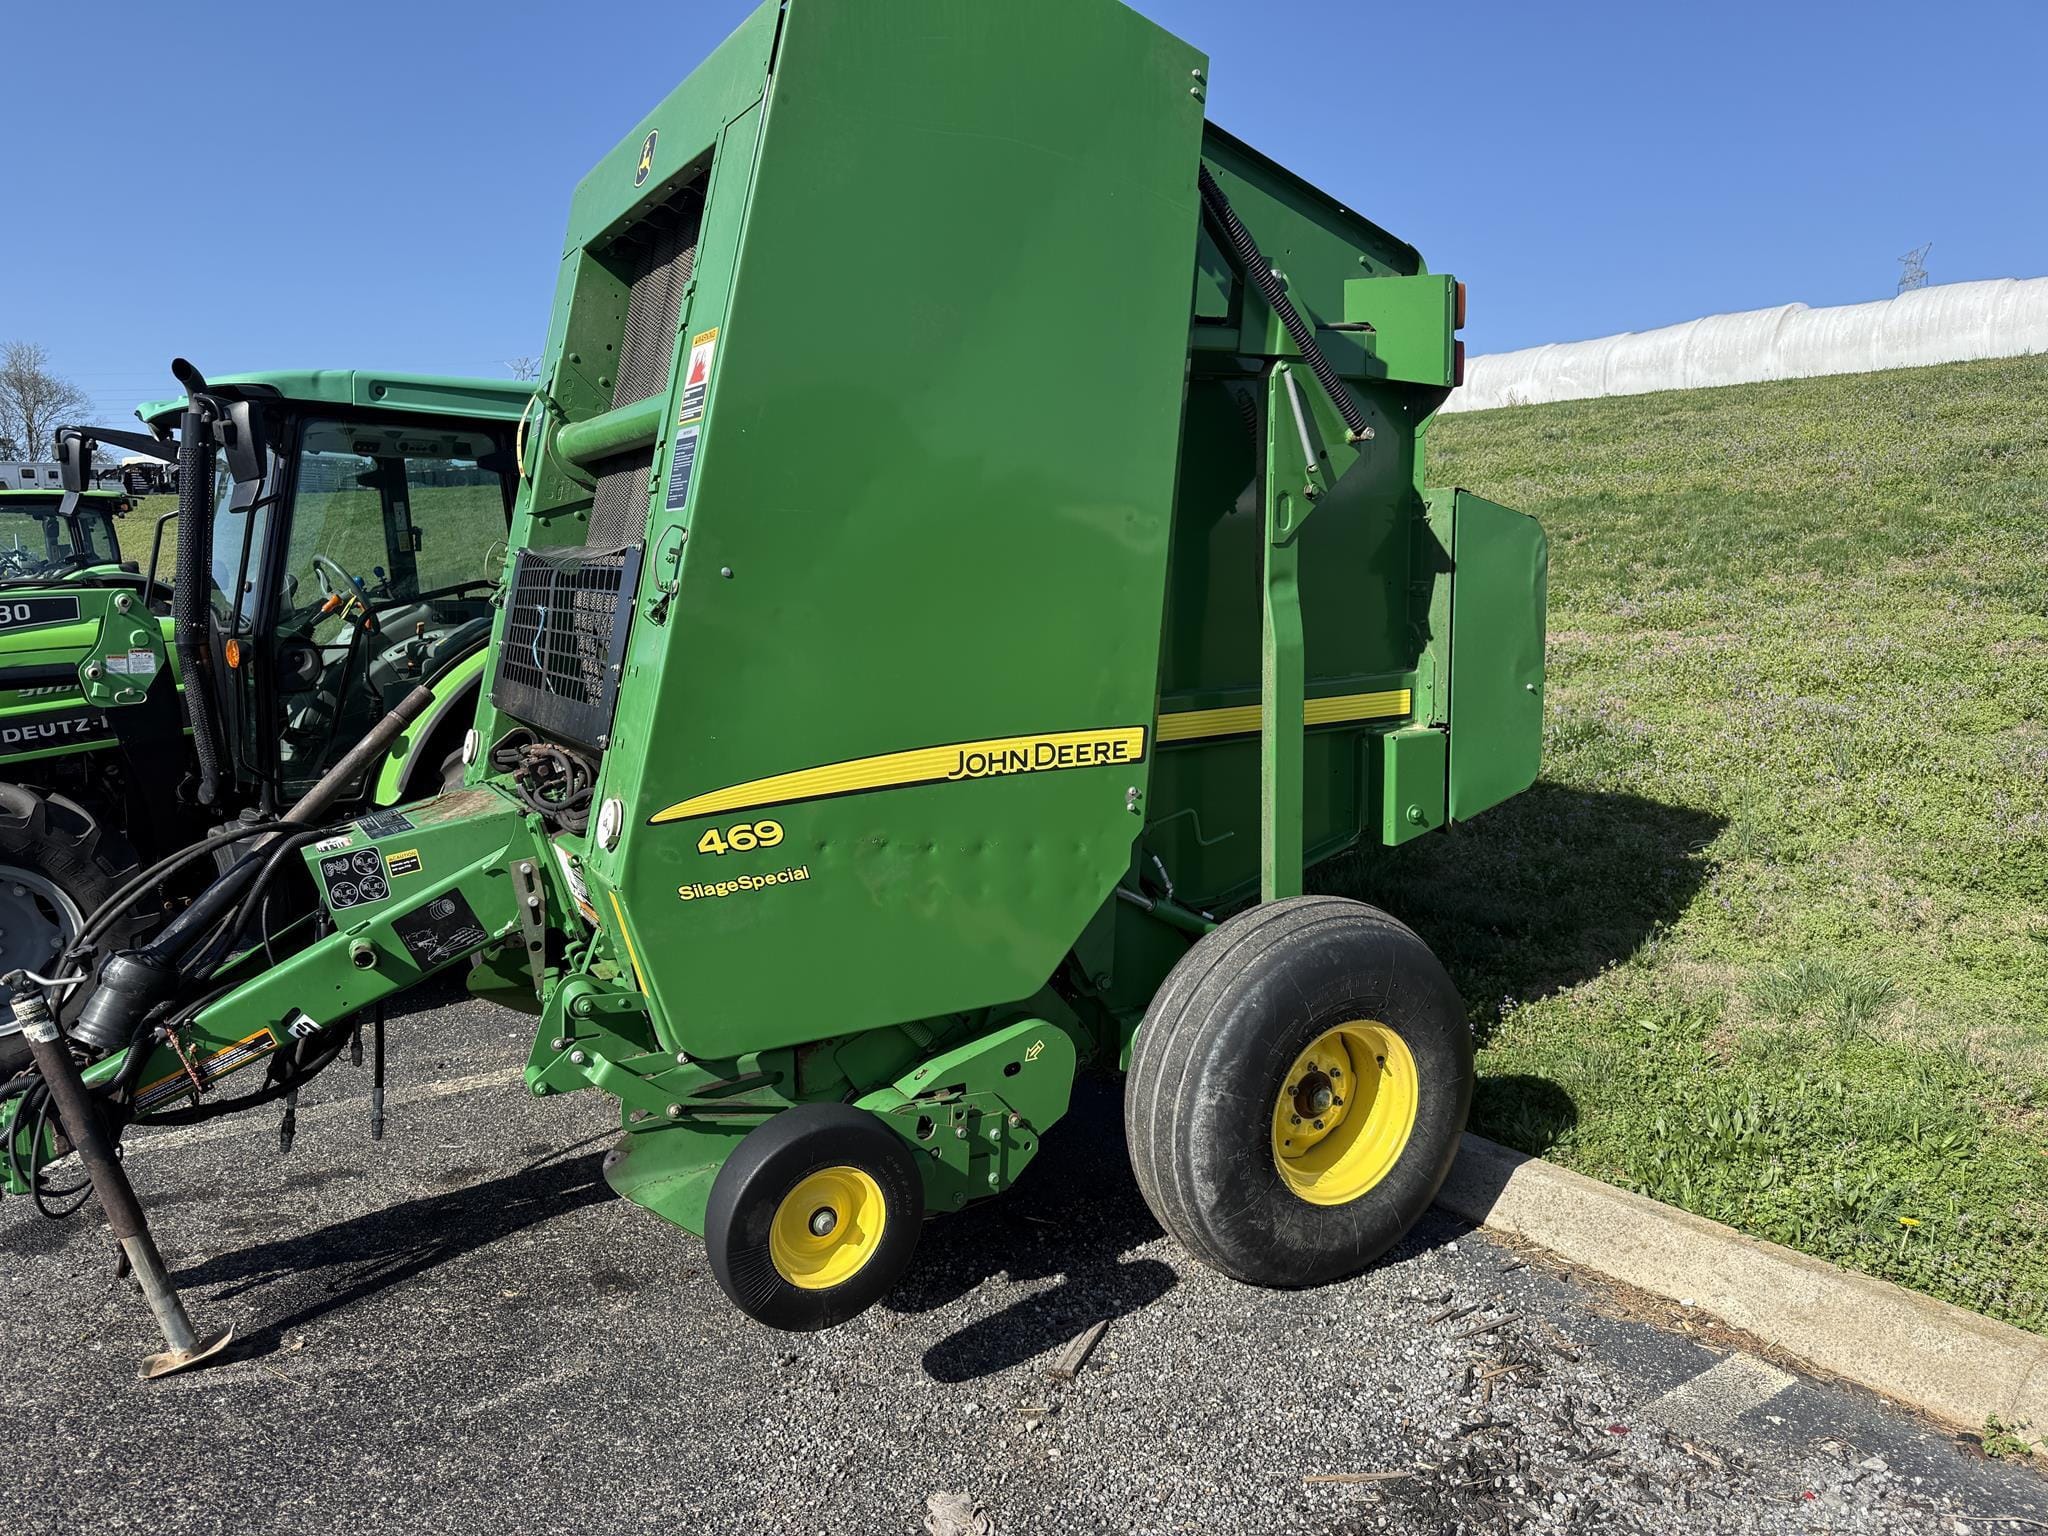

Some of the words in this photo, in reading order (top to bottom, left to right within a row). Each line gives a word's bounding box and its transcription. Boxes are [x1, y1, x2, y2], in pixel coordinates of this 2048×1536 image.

[948, 748, 1028, 777] JOHN
[1034, 740, 1128, 768] DEERE
[697, 820, 784, 855] 469
[678, 865, 810, 900] SilageSpecial
